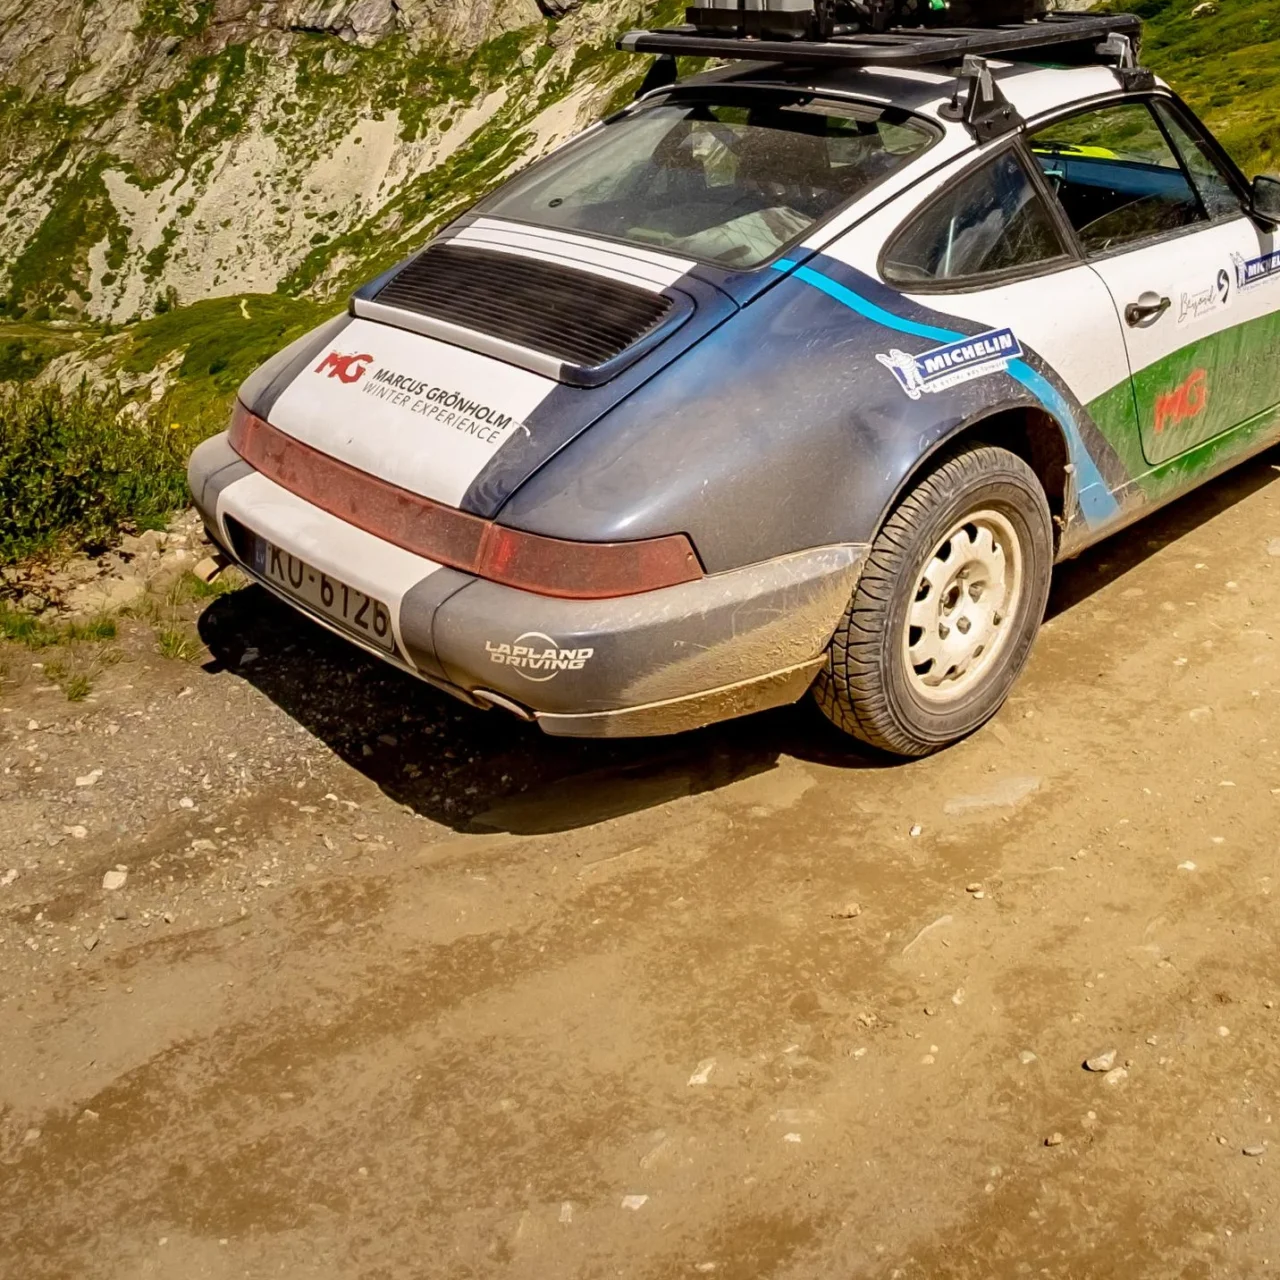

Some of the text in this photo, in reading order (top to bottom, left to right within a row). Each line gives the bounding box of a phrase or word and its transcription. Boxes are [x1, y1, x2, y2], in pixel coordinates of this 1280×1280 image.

[314, 352, 374, 384] MG
[924, 333, 1013, 373] MICHELIN
[361, 380, 500, 444] WINTER EXPERIENCE
[372, 368, 513, 430] MARCUS GRÖNHOLM
[485, 640, 595, 660] LAPLAND
[490, 652, 587, 670] DRIVING
